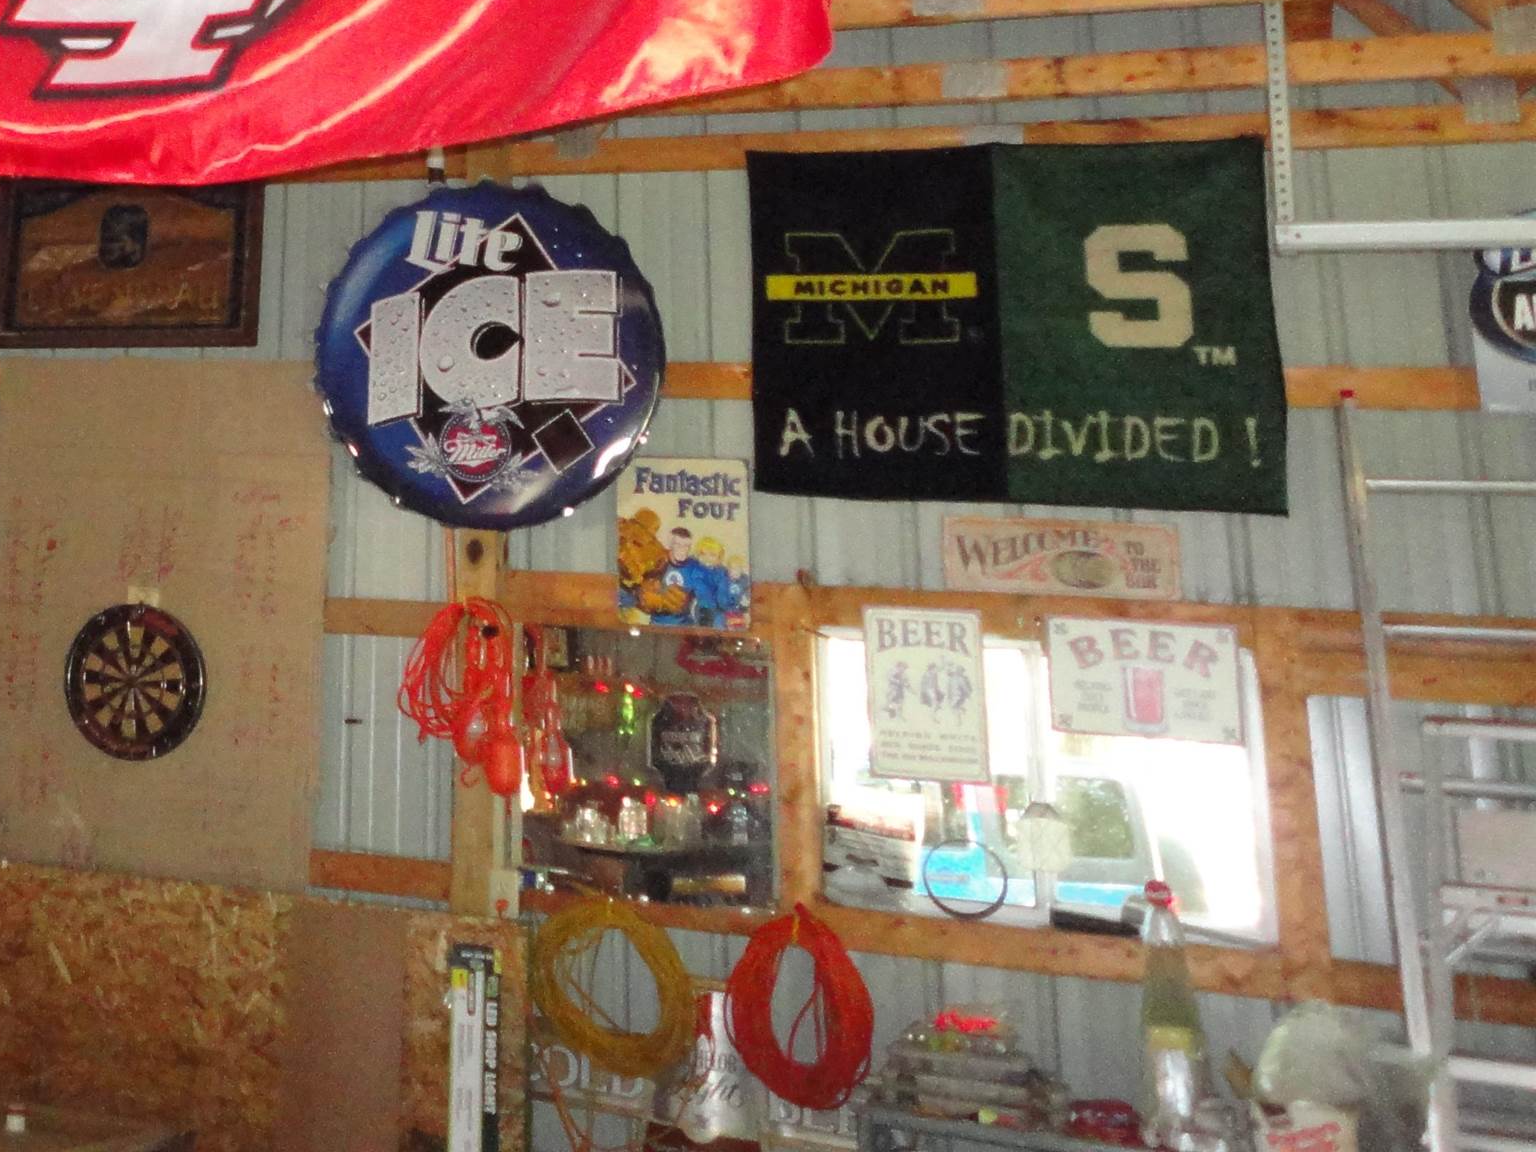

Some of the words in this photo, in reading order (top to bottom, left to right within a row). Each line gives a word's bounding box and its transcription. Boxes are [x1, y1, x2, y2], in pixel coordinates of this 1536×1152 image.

[406, 209, 524, 273] Lite
[793, 279, 951, 297] MICHIGAN
[1083, 223, 1196, 348] S
[367, 269, 624, 427] ICE
[779, 408, 814, 458] A
[834, 410, 988, 457] HOUSE
[1007, 409, 1221, 462] DIVIDED
[633, 466, 741, 498] Fantastic
[875, 617, 970, 657] BEER
[1067, 627, 1220, 679] BEER
